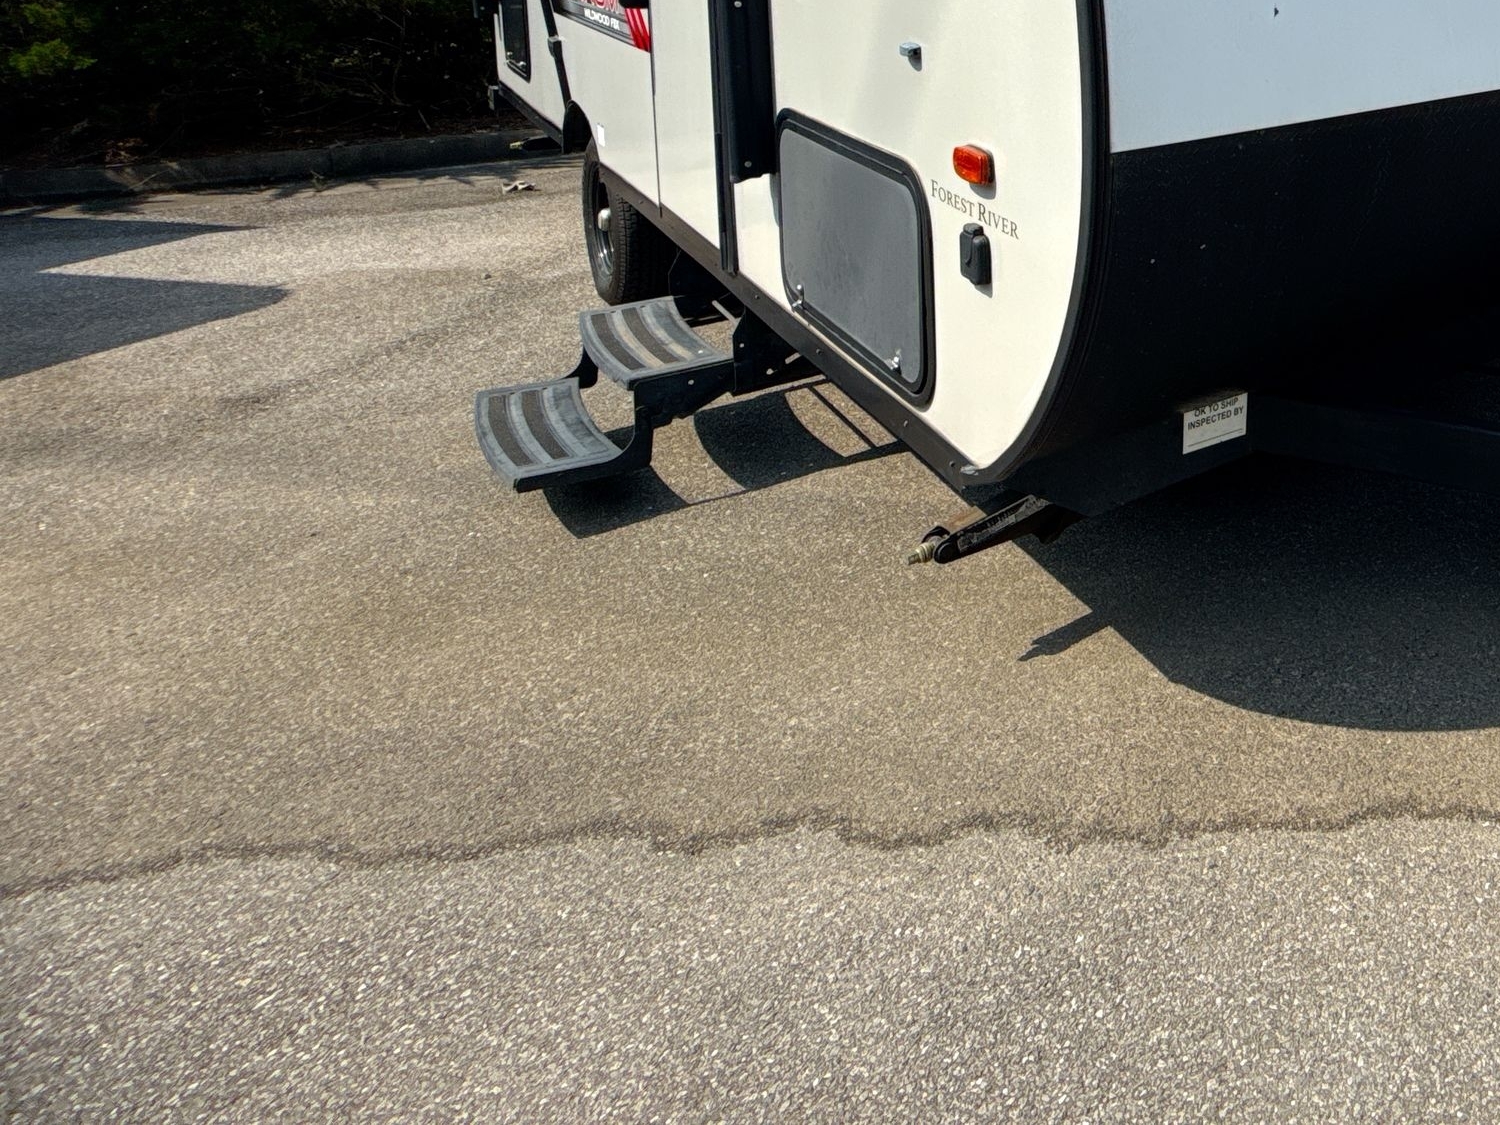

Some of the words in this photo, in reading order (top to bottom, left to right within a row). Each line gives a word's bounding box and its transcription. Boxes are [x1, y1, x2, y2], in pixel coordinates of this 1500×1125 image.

[931, 179, 975, 217] FOREST
[978, 202, 1019, 240] RIVER
[1188, 410, 1231, 430] INSPECTED
[1234, 405, 1244, 416] BY
[1208, 403, 1219, 413] TO
[1221, 397, 1239, 409] SHIP
